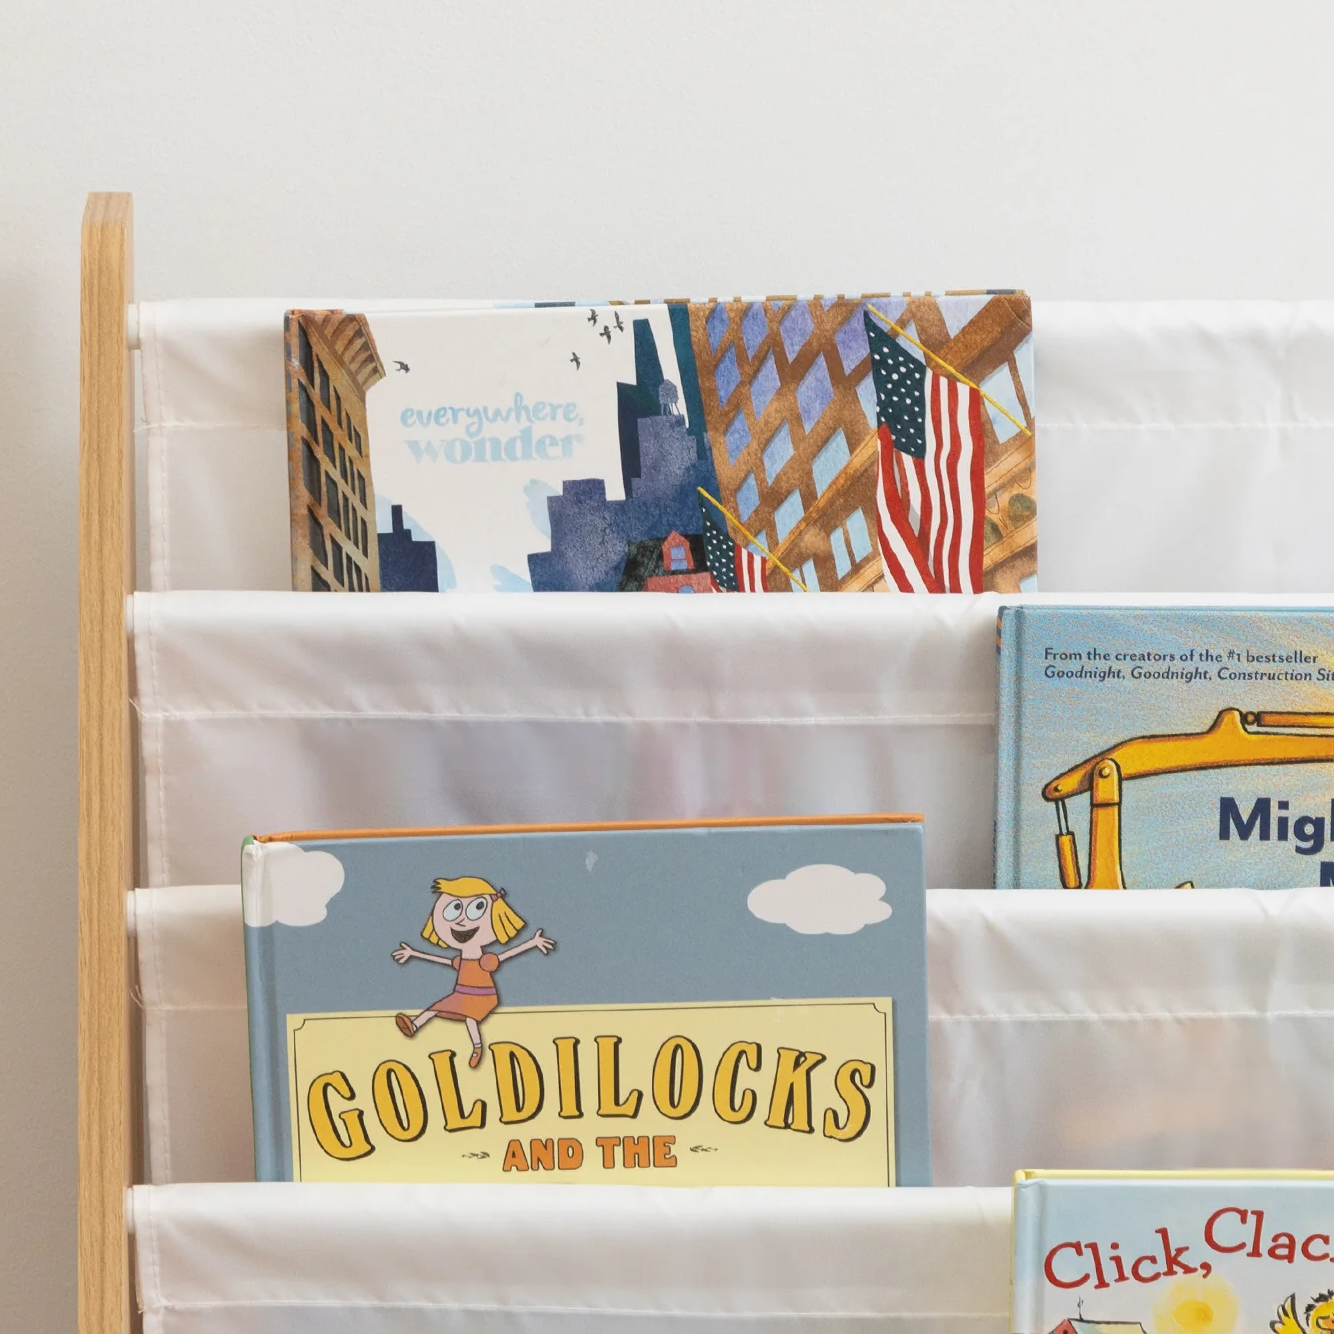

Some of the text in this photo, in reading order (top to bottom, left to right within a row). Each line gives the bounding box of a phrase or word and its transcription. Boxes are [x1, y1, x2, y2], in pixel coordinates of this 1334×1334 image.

[399, 391, 585, 439] everywhere,
[403, 425, 585, 465] wonder
[1044, 648, 1319, 664] From the creators of the #1 bestseller
[1044, 665, 1126, 682] Goodnight,
[1130, 666, 1213, 683] Goodnight,
[1217, 667, 1313, 682] Construction
[306, 1035, 877, 1162] GOLDILOCKS
[502, 1135, 679, 1172] AND THE
[1043, 1228, 1212, 1290] Click,
